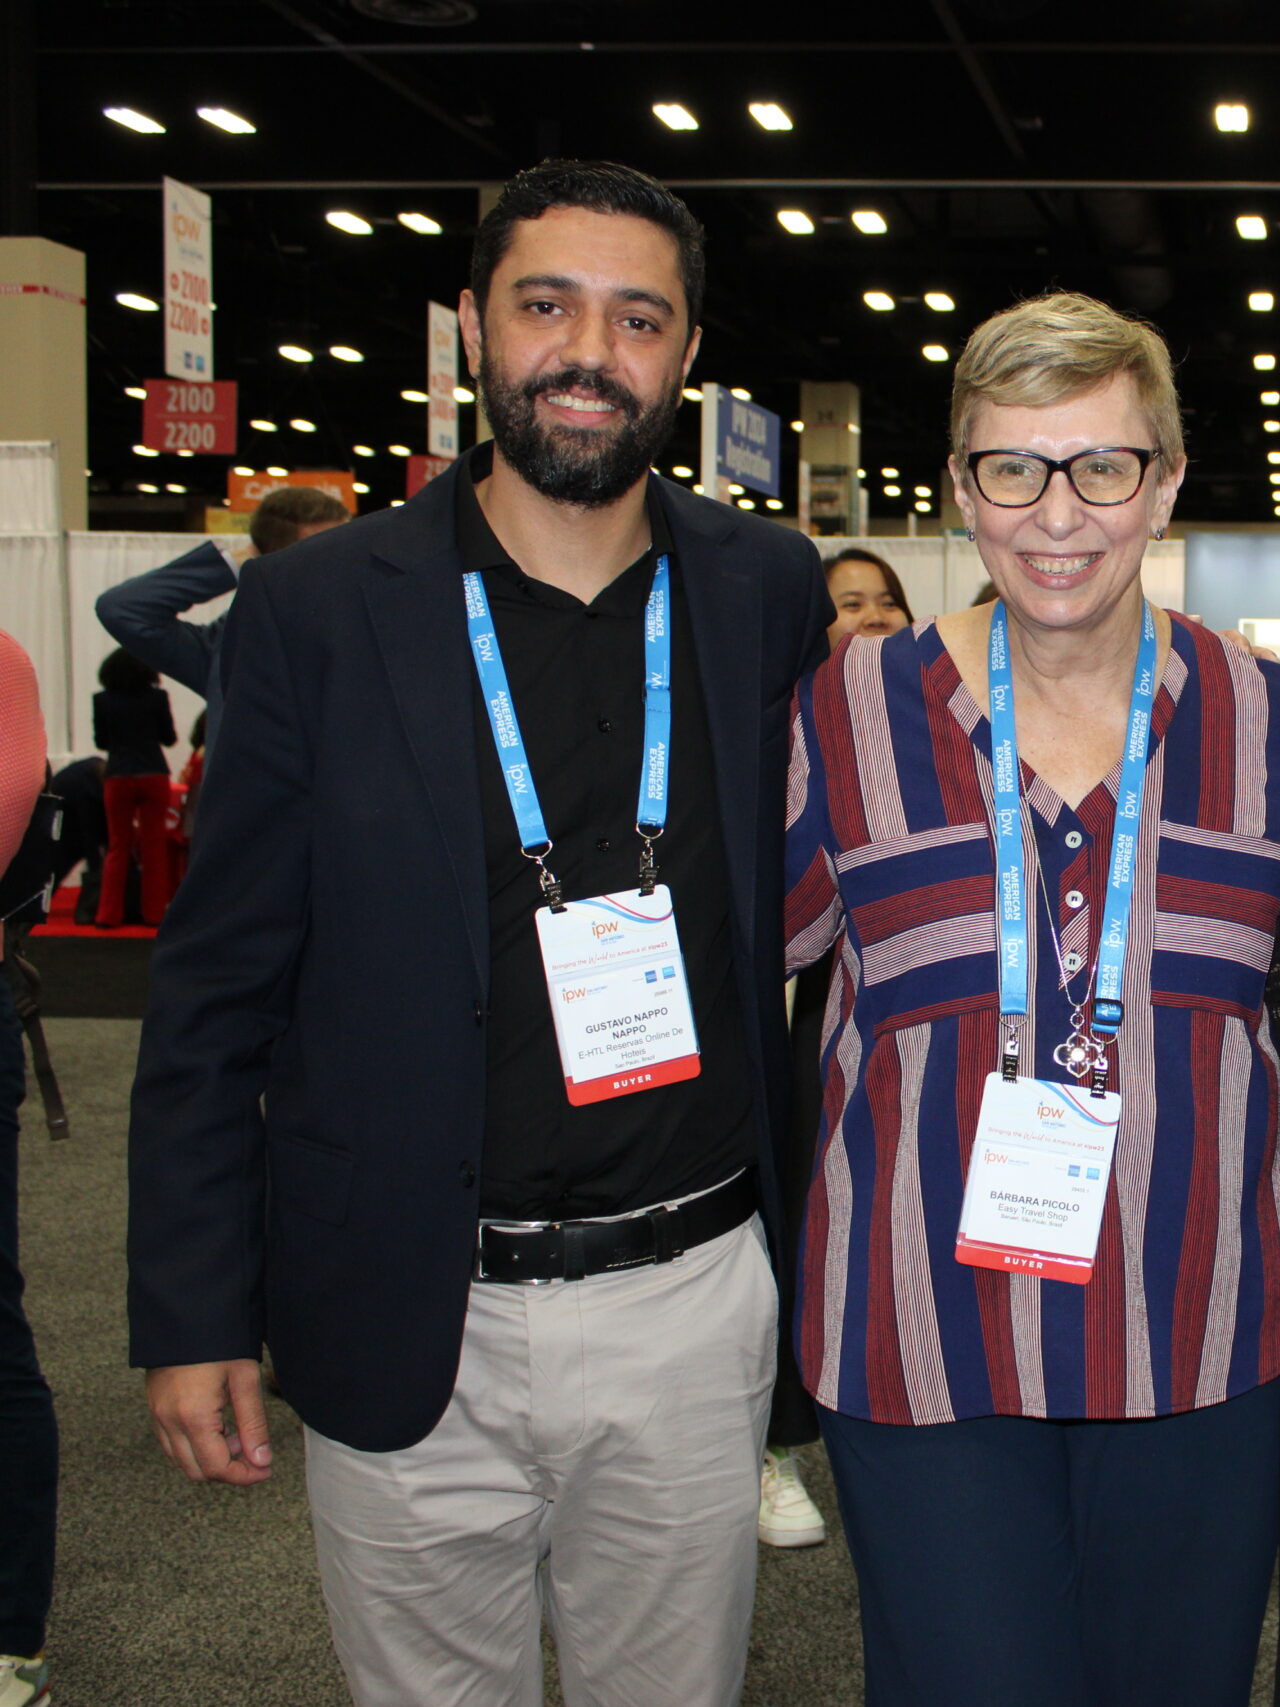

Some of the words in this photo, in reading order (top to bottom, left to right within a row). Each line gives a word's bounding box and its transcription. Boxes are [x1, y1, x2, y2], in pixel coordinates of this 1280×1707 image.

[166, 386, 215, 412] 2100
[164, 423, 216, 448] 2200
[655, 590, 664, 637] EXPRESS
[1136, 668, 1151, 697] ipw
[991, 684, 1010, 712] ipw
[490, 699, 511, 748] EXPRESS
[497, 690, 519, 748] AMERICAN
[1128, 709, 1142, 763] AMERICAN
[1136, 711, 1148, 758] EXPRESS
[506, 763, 529, 794] ipw
[647, 747, 658, 800] EXPRESS
[655, 741, 666, 801] AMERICAN
[995, 746, 1006, 793] EXPRESS
[1002, 738, 1014, 793] AMERICAN
[1119, 790, 1138, 819] ipw
[997, 808, 1018, 837] ipw
[1112, 833, 1126, 889] AMERICAN
[1121, 835, 1134, 883] EXPRESS
[1002, 872, 1013, 921] EXPRESS
[1010, 865, 1021, 921] AMERICAN
[592, 921, 618, 939] ipw
[1104, 918, 1124, 948] ipw
[1003, 938, 1024, 968] ipw
[562, 987, 586, 1004] ipw
[585, 1016, 632, 1034] GUSTAVO
[634, 1007, 668, 1022] NAPPO
[612, 1024, 647, 1040] NAPPO
[578, 1046, 604, 1060] E-HTL
[606, 1038, 644, 1053] Reservas
[645, 1031, 670, 1043] Online
[672, 1027, 683, 1036] De
[621, 1048, 646, 1060] Hotels
[613, 1074, 652, 1089] BUYER
[1037, 1101, 1064, 1119] ipw
[984, 1148, 1008, 1164] ipw
[998, 1203, 1018, 1214] Easy
[1021, 1206, 1045, 1217] Travel
[1047, 1210, 1069, 1222] Shop
[1041, 1199, 1080, 1212] PICOLO
[1004, 1256, 1043, 1269] BUYER
